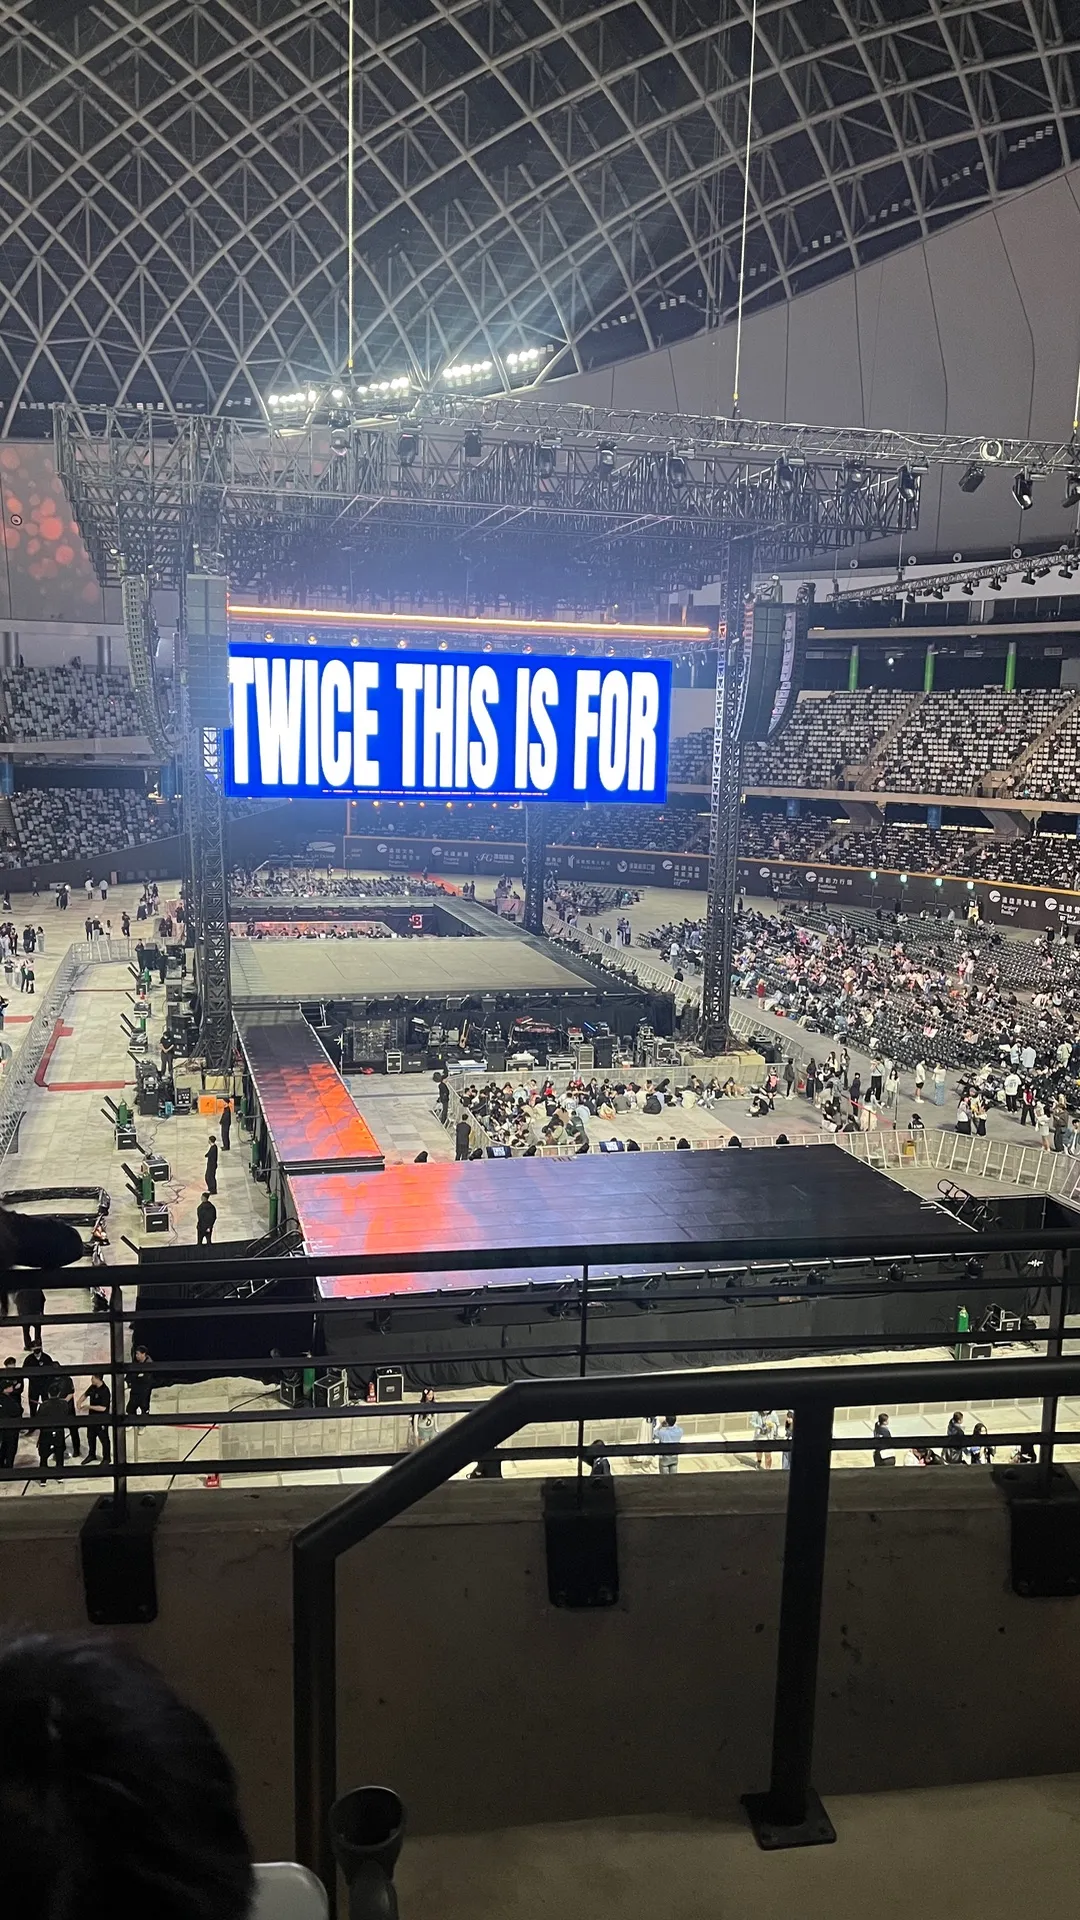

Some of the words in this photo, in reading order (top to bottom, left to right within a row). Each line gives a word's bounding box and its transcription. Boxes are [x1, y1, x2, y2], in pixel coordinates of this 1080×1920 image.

[229, 656, 380, 787] TWICE
[395, 662, 500, 790] THIS
[514, 667, 560, 790] IS
[573, 668, 660, 792] FOR
